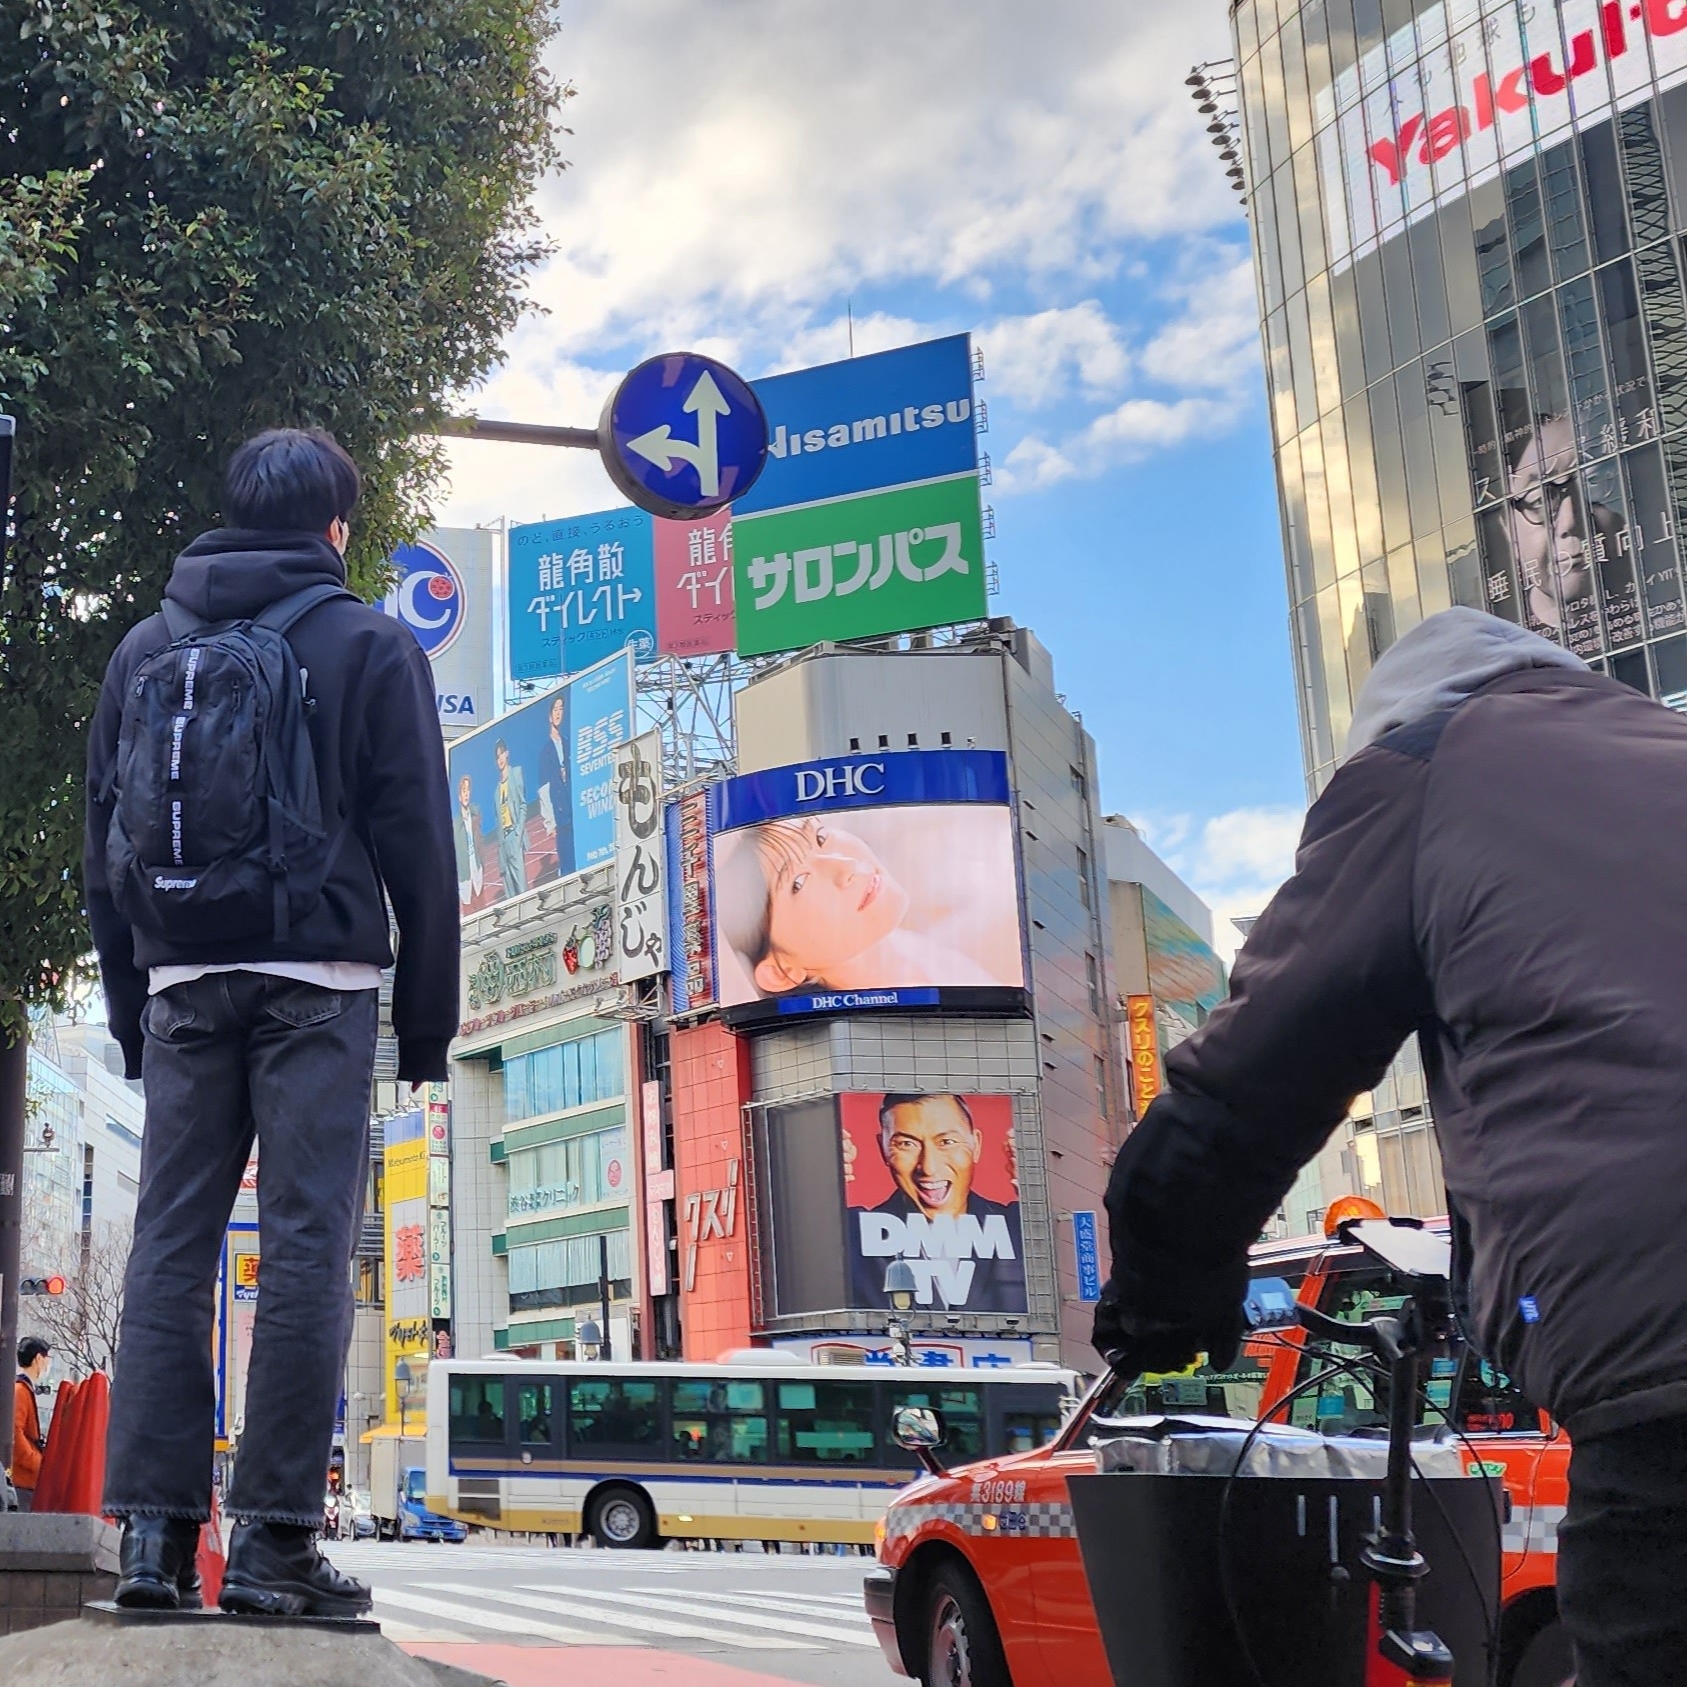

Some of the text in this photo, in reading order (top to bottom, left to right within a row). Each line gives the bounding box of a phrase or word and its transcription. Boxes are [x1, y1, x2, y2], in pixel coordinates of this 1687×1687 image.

[537, 540, 625, 591] 龍角散
[676, 565, 735, 609] ダイ
[747, 521, 970, 610] サロンパス
[526, 583, 643, 632] ダイレクト
[182, 648, 200, 711] SUPREME
[170, 716, 186, 780] SUPREME
[576, 708, 624, 765] BSS
[795, 763, 885, 802] DHC
[618, 743, 662, 968] もんじゃ
[812, 991, 898, 1010] DHC Channel
[684, 1158, 740, 1292] クスリ
[858, 1212, 1016, 1260] DMM
[396, 1223, 425, 1283] 薬
[905, 1258, 976, 1311] TV
